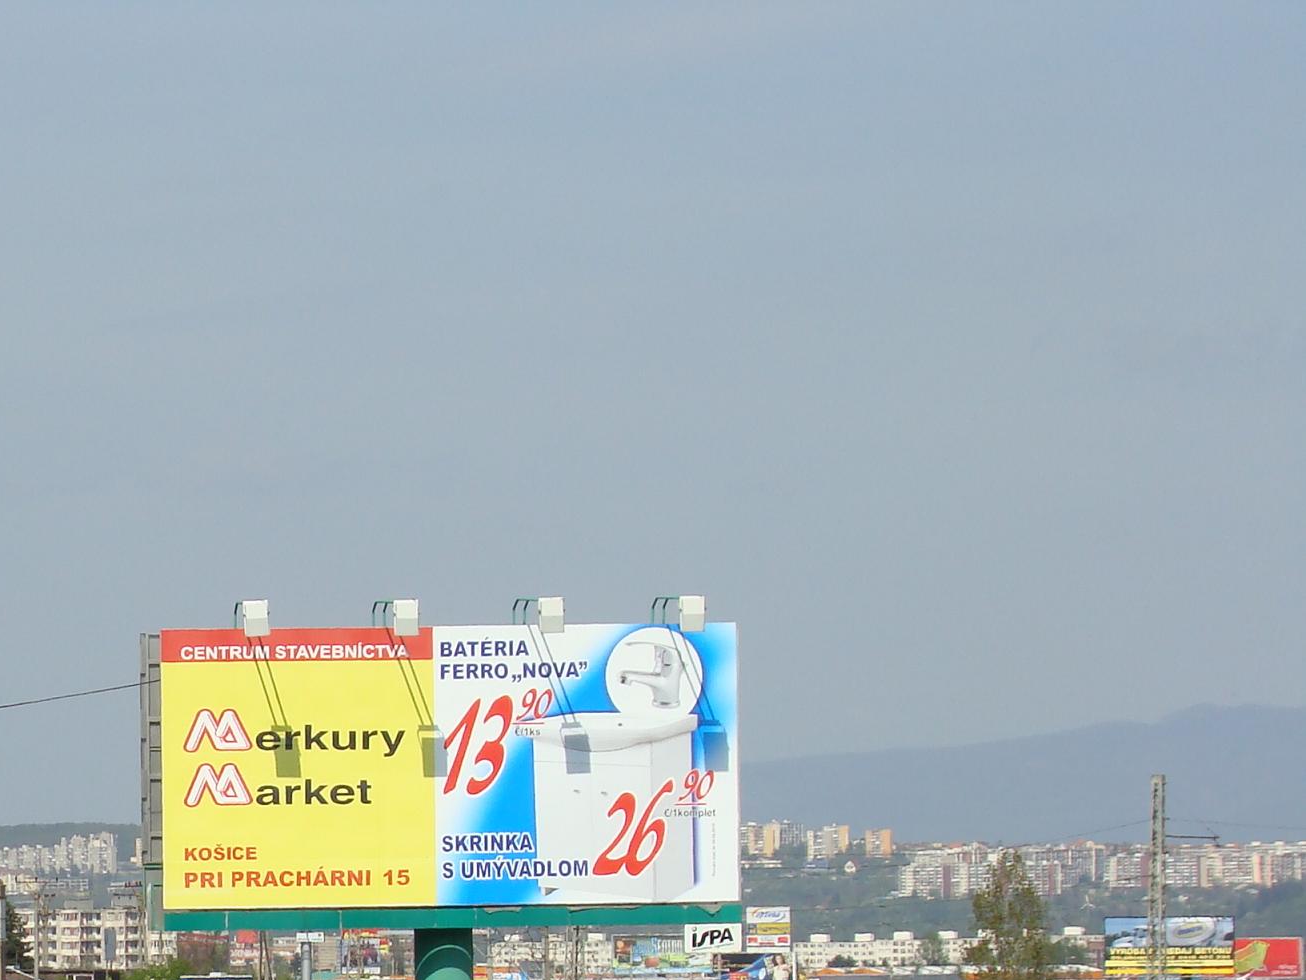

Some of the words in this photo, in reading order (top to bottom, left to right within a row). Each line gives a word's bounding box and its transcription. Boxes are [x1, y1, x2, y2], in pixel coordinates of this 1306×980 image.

[181, 645, 270, 660] CENTRUM
[275, 641, 409, 659] STAVEBNÍCTVA
[440, 637, 529, 657] BATÉRIA
[440, 663, 508, 680] FERRO
[183, 708, 405, 757] Merkury
[444, 695, 513, 795] 13
[184, 763, 372, 807] Market
[593, 779, 674, 876] 26
[184, 844, 257, 861] KOŠICE
[442, 833, 533, 852] SKRINKA
[184, 871, 222, 888] PRI
[232, 866, 371, 887] PRACHÁRNI
[383, 869, 410, 886] 15
[443, 862, 454, 879] S
[461, 857, 588, 879] UMÝVADLOM
